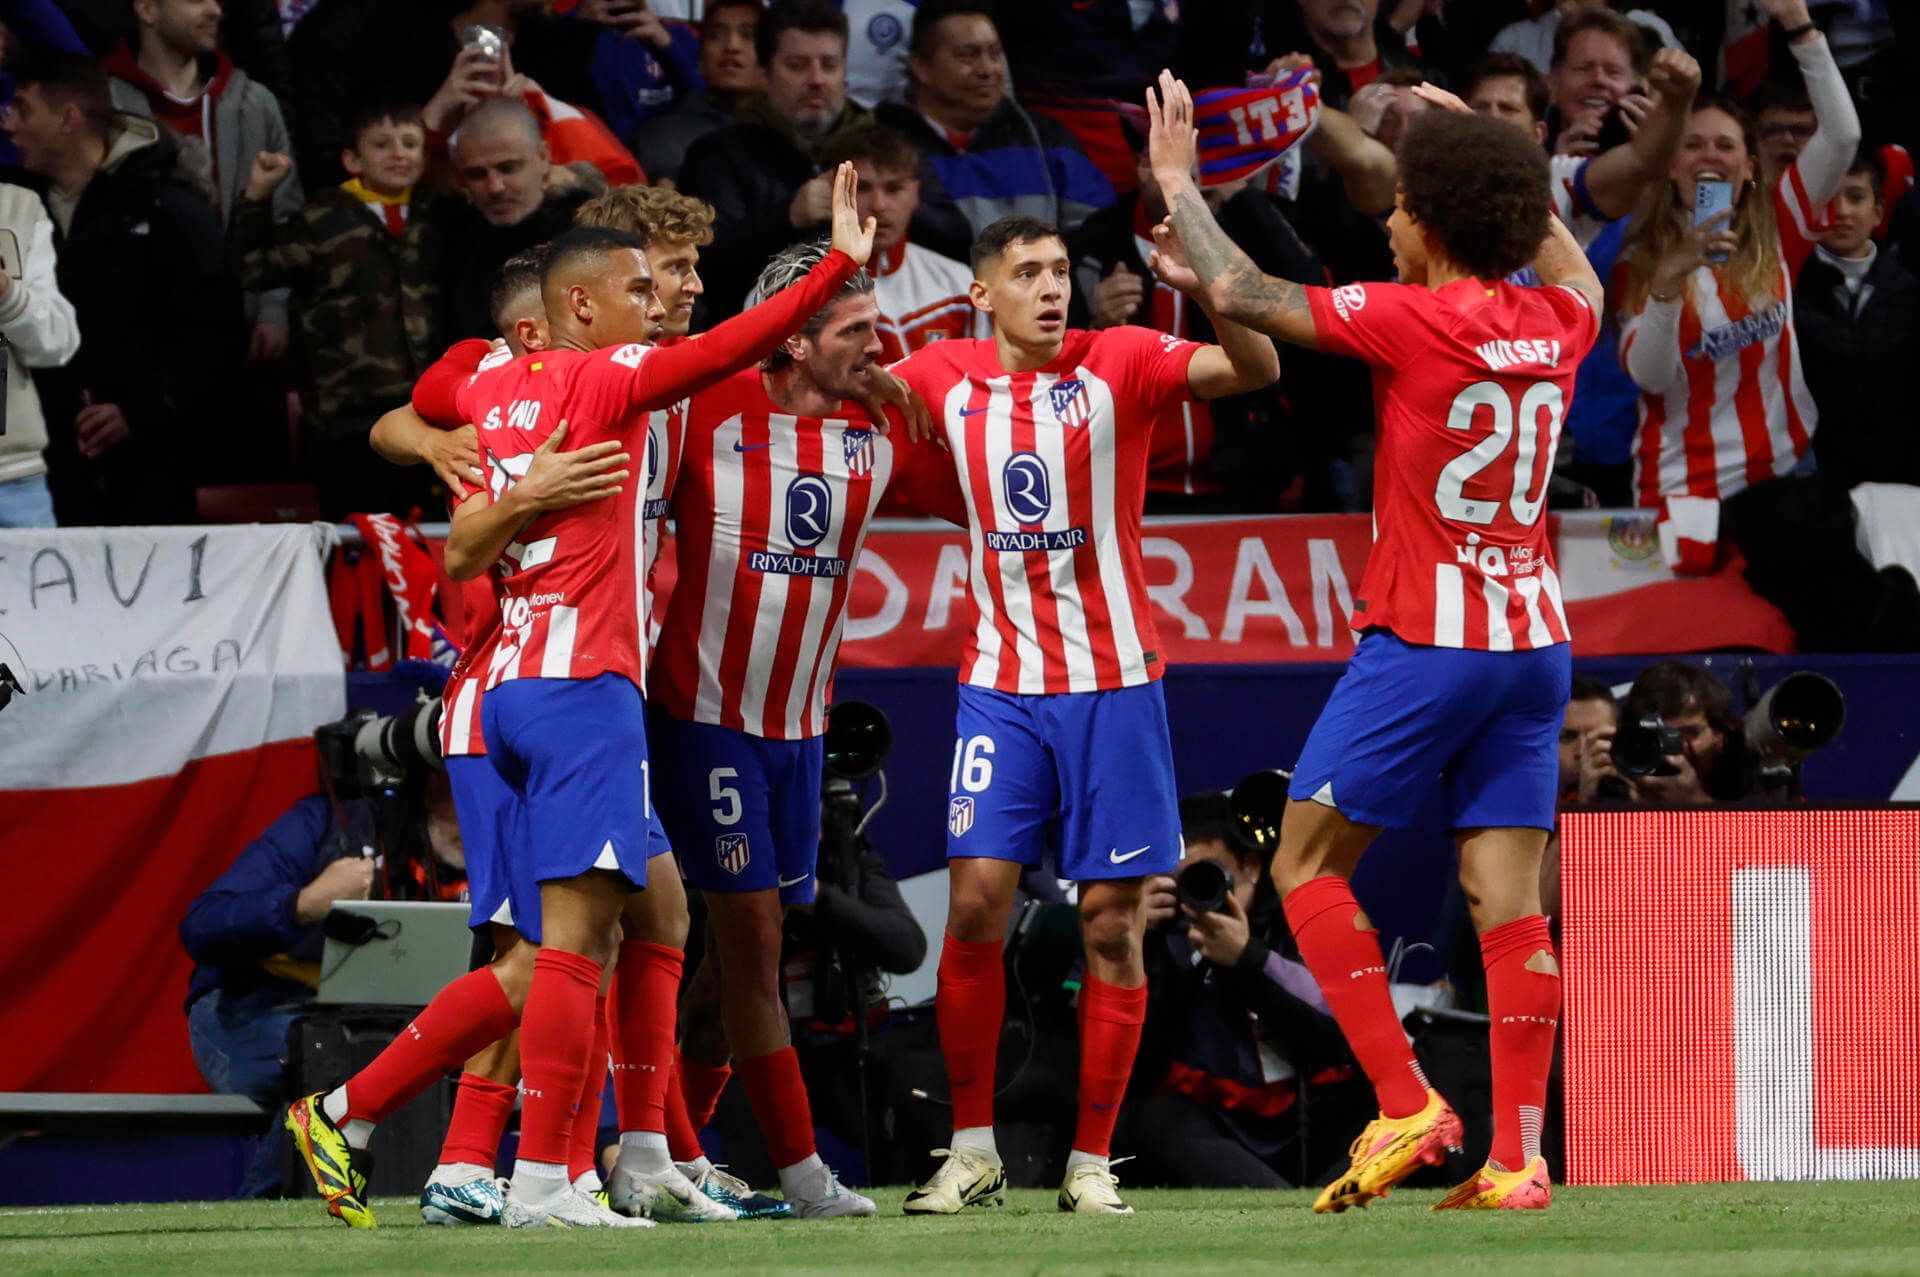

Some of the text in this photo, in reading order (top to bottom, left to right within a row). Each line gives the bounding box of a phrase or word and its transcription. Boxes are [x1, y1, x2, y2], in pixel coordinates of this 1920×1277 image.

[1434, 381, 1564, 526] 20
[752, 553, 846, 576] RIYADH AIR
[987, 530, 1085, 550] RIYADH AIR
[0, 533, 208, 616] AVI
[950, 735, 996, 794] 16
[708, 767, 743, 825] 5
